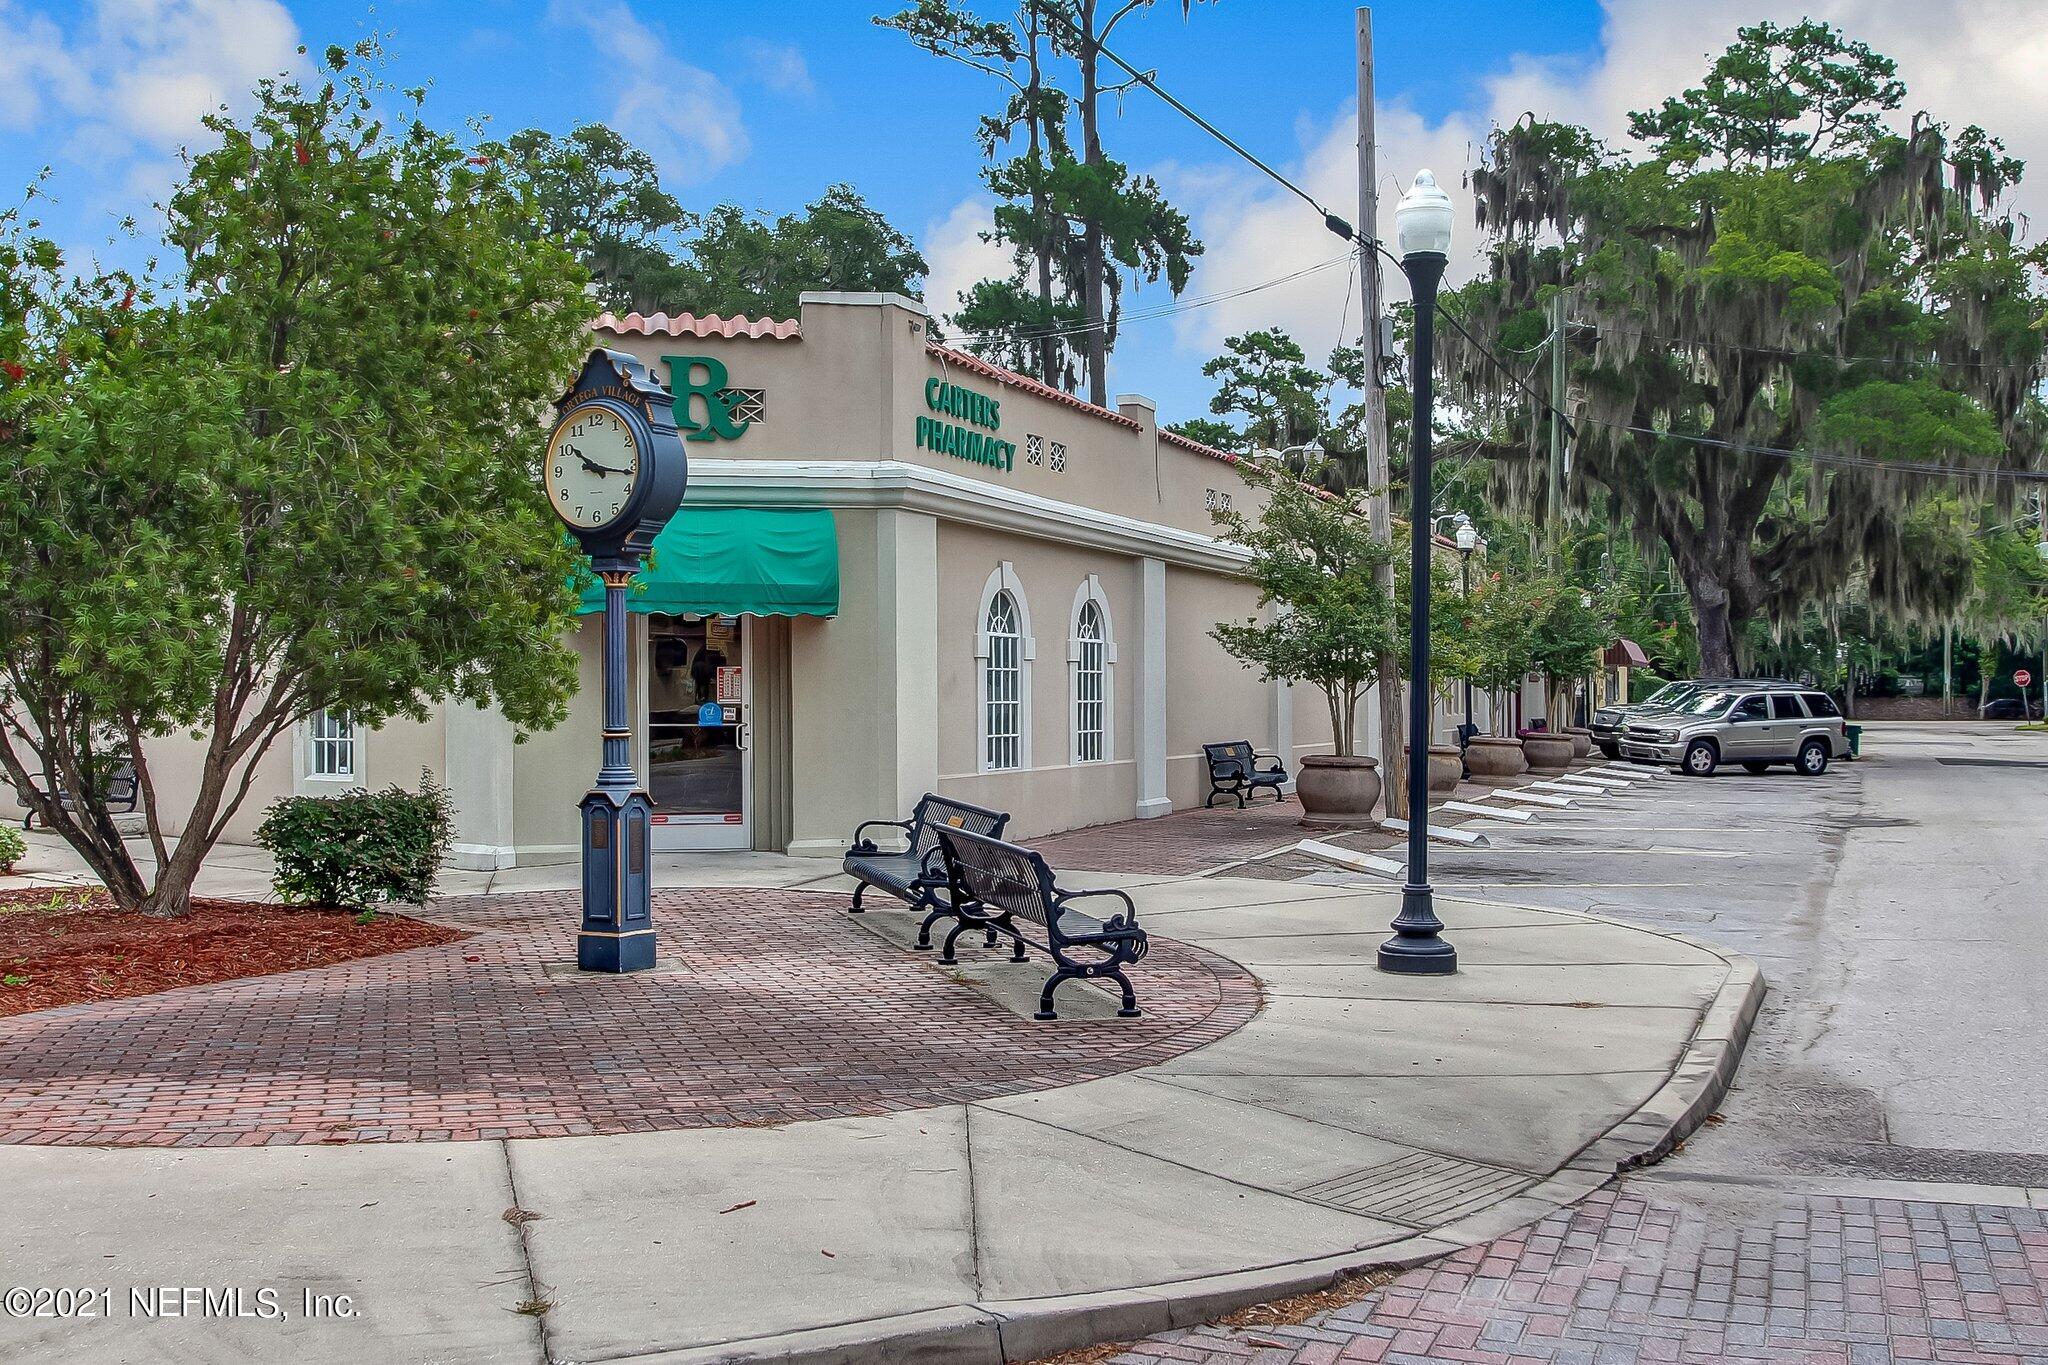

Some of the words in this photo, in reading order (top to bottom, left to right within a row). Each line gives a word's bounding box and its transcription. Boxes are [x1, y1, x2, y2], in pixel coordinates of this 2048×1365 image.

[562, 387, 598, 415] ORTEGA
[602, 385, 641, 408] VILLAGE
[925, 377, 1000, 431] CARTERS
[588, 414, 604, 428] 12
[611, 419, 619, 431] 1
[571, 425, 585, 438] 11
[624, 436, 633, 448] 2
[916, 415, 1017, 473] PHARMACY
[558, 444, 574, 457] 10
[630, 459, 637, 471] 3
[554, 466, 563, 479] 9
[560, 488, 569, 501] 8
[623, 483, 632, 496] 4
[575, 507, 584, 519] 7
[611, 503, 620, 515] 5
[592, 511, 601, 523] 6
